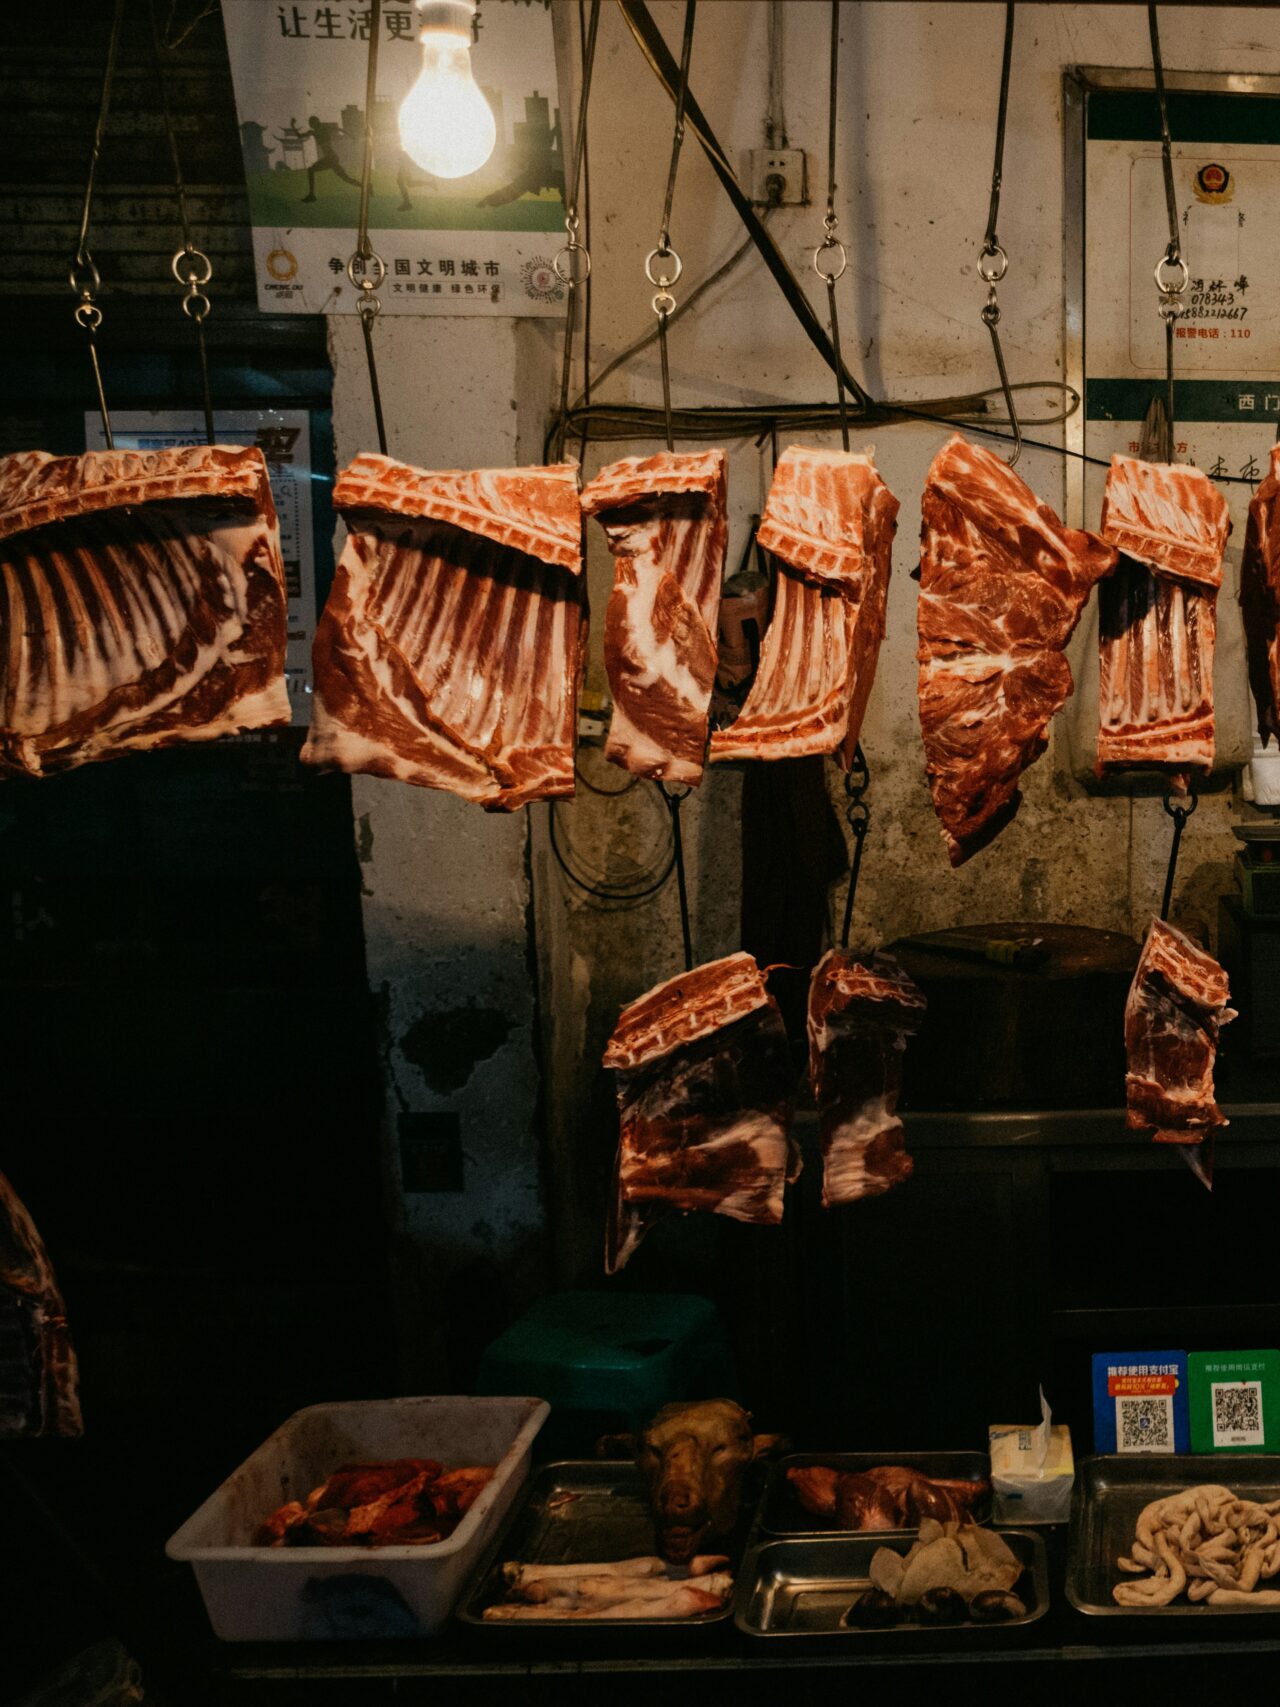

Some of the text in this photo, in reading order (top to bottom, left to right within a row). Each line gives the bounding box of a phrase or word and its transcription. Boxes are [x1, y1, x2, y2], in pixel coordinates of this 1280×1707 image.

[328, 257, 500, 277] 争创全国文明城市
[392, 282, 501, 295] 文明健康 绿色环保
[1107, 1363, 1179, 1376] 推荐使用支付宝
